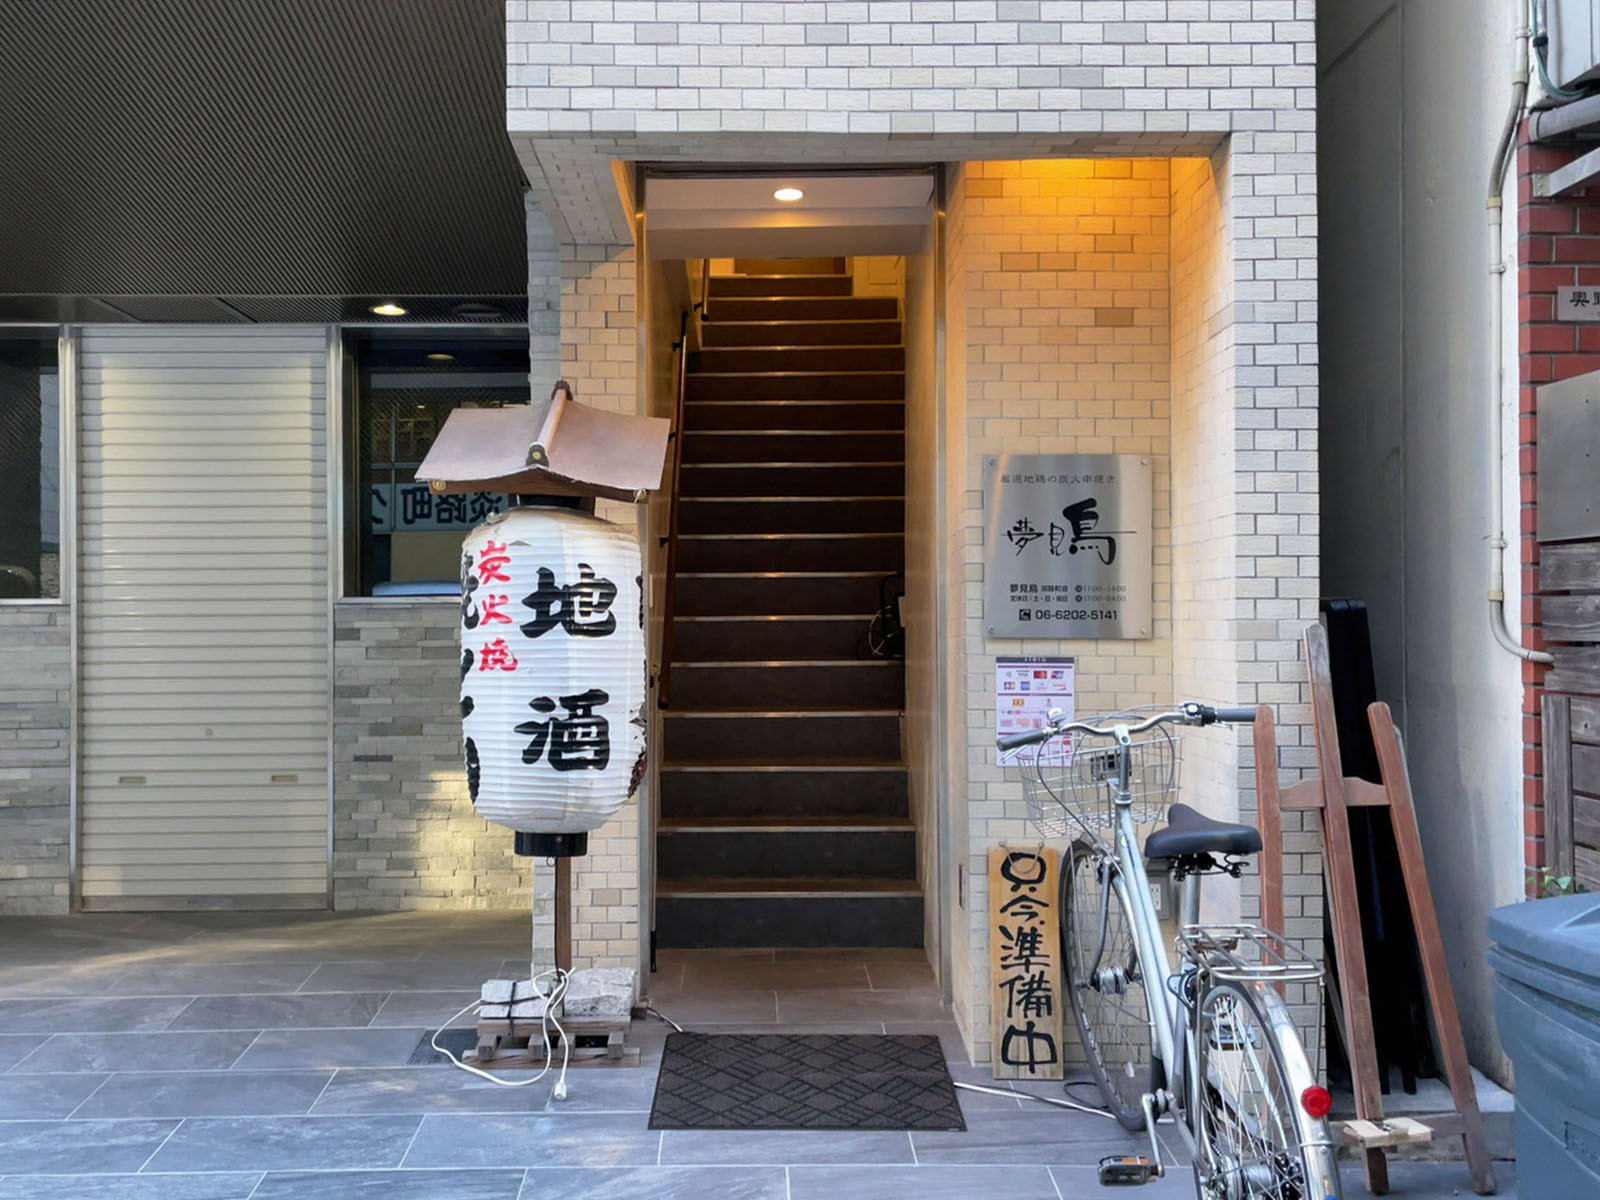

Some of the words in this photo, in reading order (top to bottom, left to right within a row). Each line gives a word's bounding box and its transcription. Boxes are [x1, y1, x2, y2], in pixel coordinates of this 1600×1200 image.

[1003, 497, 1119, 566] 夢見鳥
[477, 540, 518, 671] 炭火焼
[513, 563, 618, 772] 地酒
[1035, 609, 1118, 620] 06-6202-5141
[998, 852, 1058, 1074] 只今準備中
